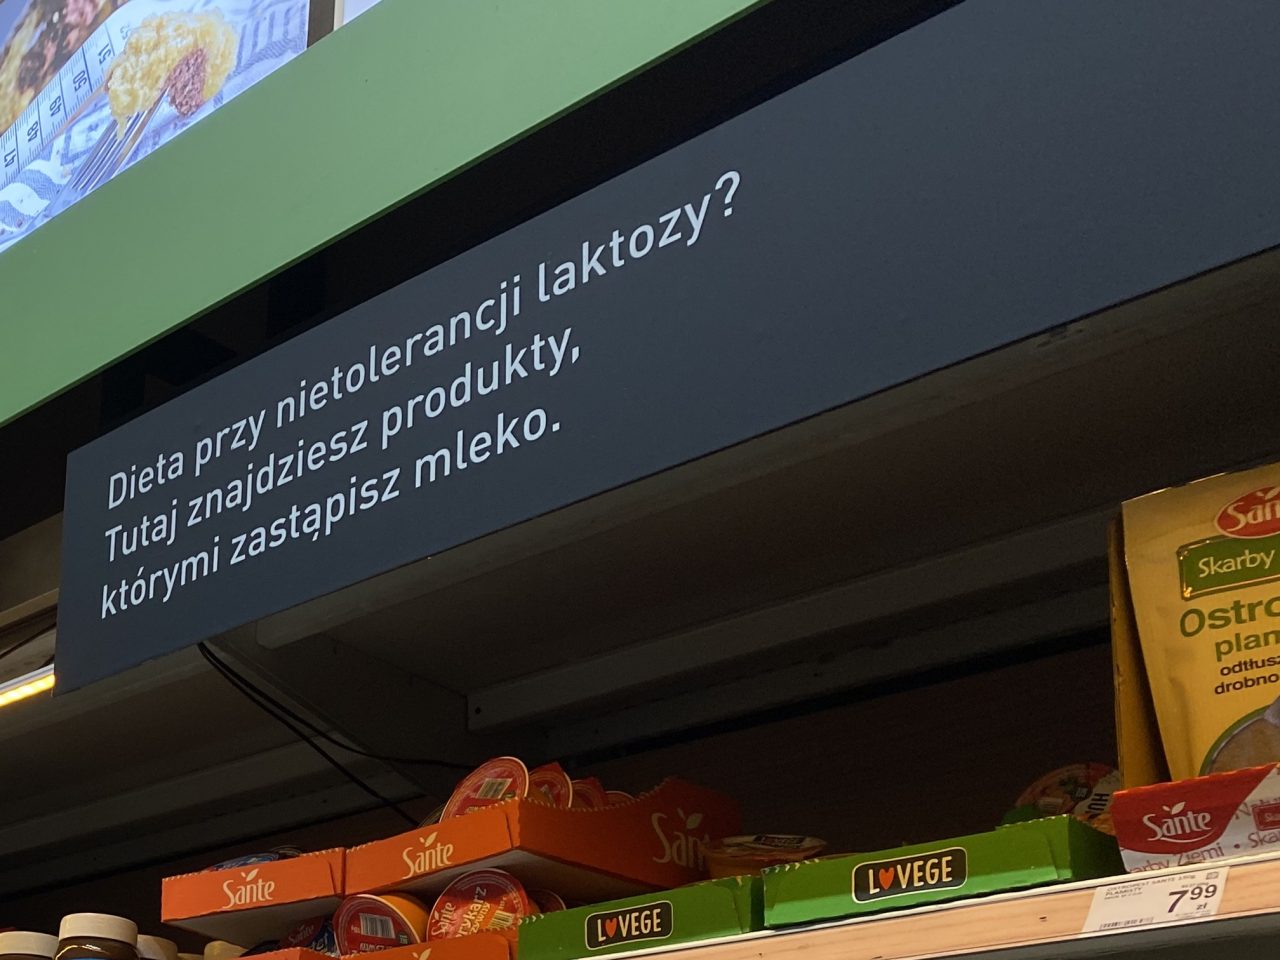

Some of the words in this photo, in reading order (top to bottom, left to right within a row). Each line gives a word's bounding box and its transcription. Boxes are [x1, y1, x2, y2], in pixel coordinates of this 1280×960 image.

[72, 69, 87, 92] 50
[49, 95, 62, 117] 49
[27, 121, 39, 142] 48
[107, 449, 184, 510] Dieta
[195, 410, 266, 488] przy
[276, 275, 521, 428] nietolerancji
[537, 170, 742, 302] laktozy?
[104, 501, 178, 563] Tutaj
[187, 420, 368, 529] znajdziesz
[381, 328, 581, 456] produkty,
[100, 542, 220, 619] którymi
[230, 466, 400, 564] zastąpisz
[415, 406, 561, 488] mleko.
[1198, 549, 1276, 578] Skarby
[1143, 811, 1212, 841] Sante
[402, 841, 454, 880] Sante
[222, 881, 275, 910] Sante
